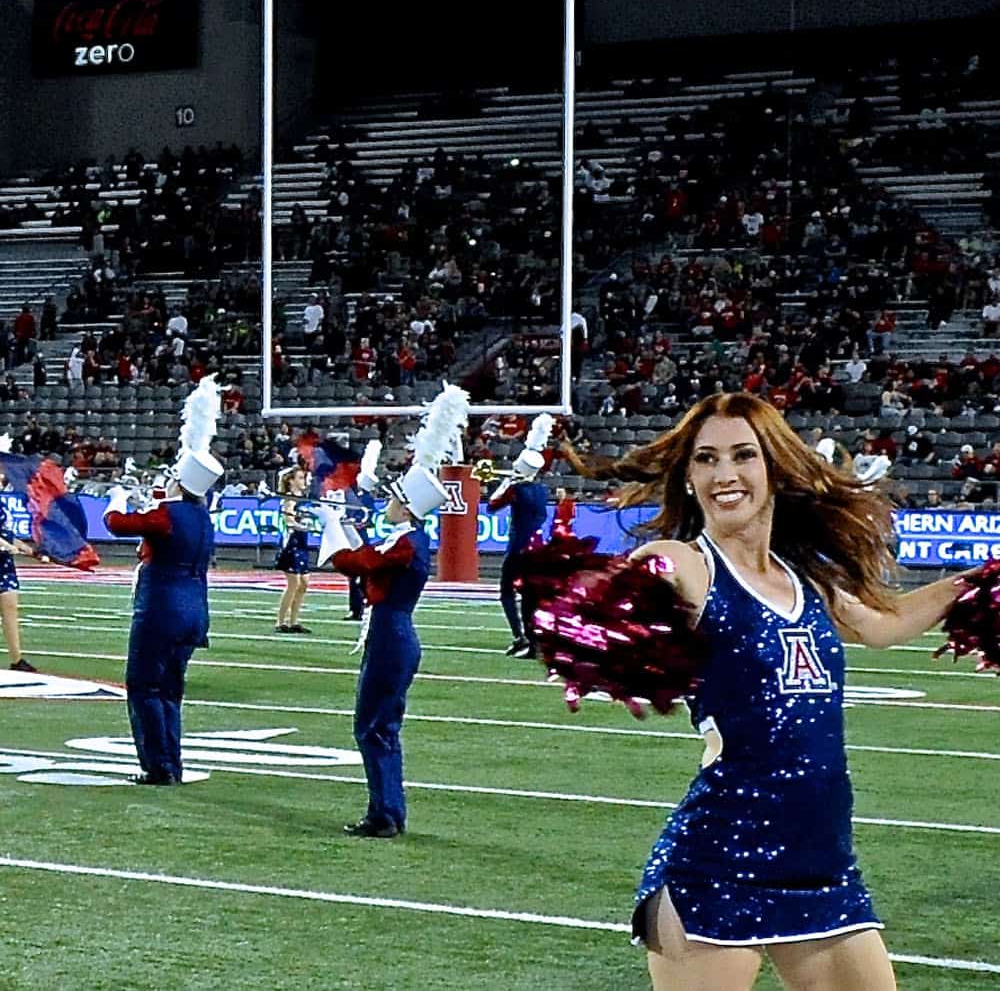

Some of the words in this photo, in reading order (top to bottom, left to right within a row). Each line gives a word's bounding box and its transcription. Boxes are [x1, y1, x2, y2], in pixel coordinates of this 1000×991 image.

[74, 42, 135, 66] zero
[175, 107, 195, 125] 10
[777, 628, 832, 694] A
